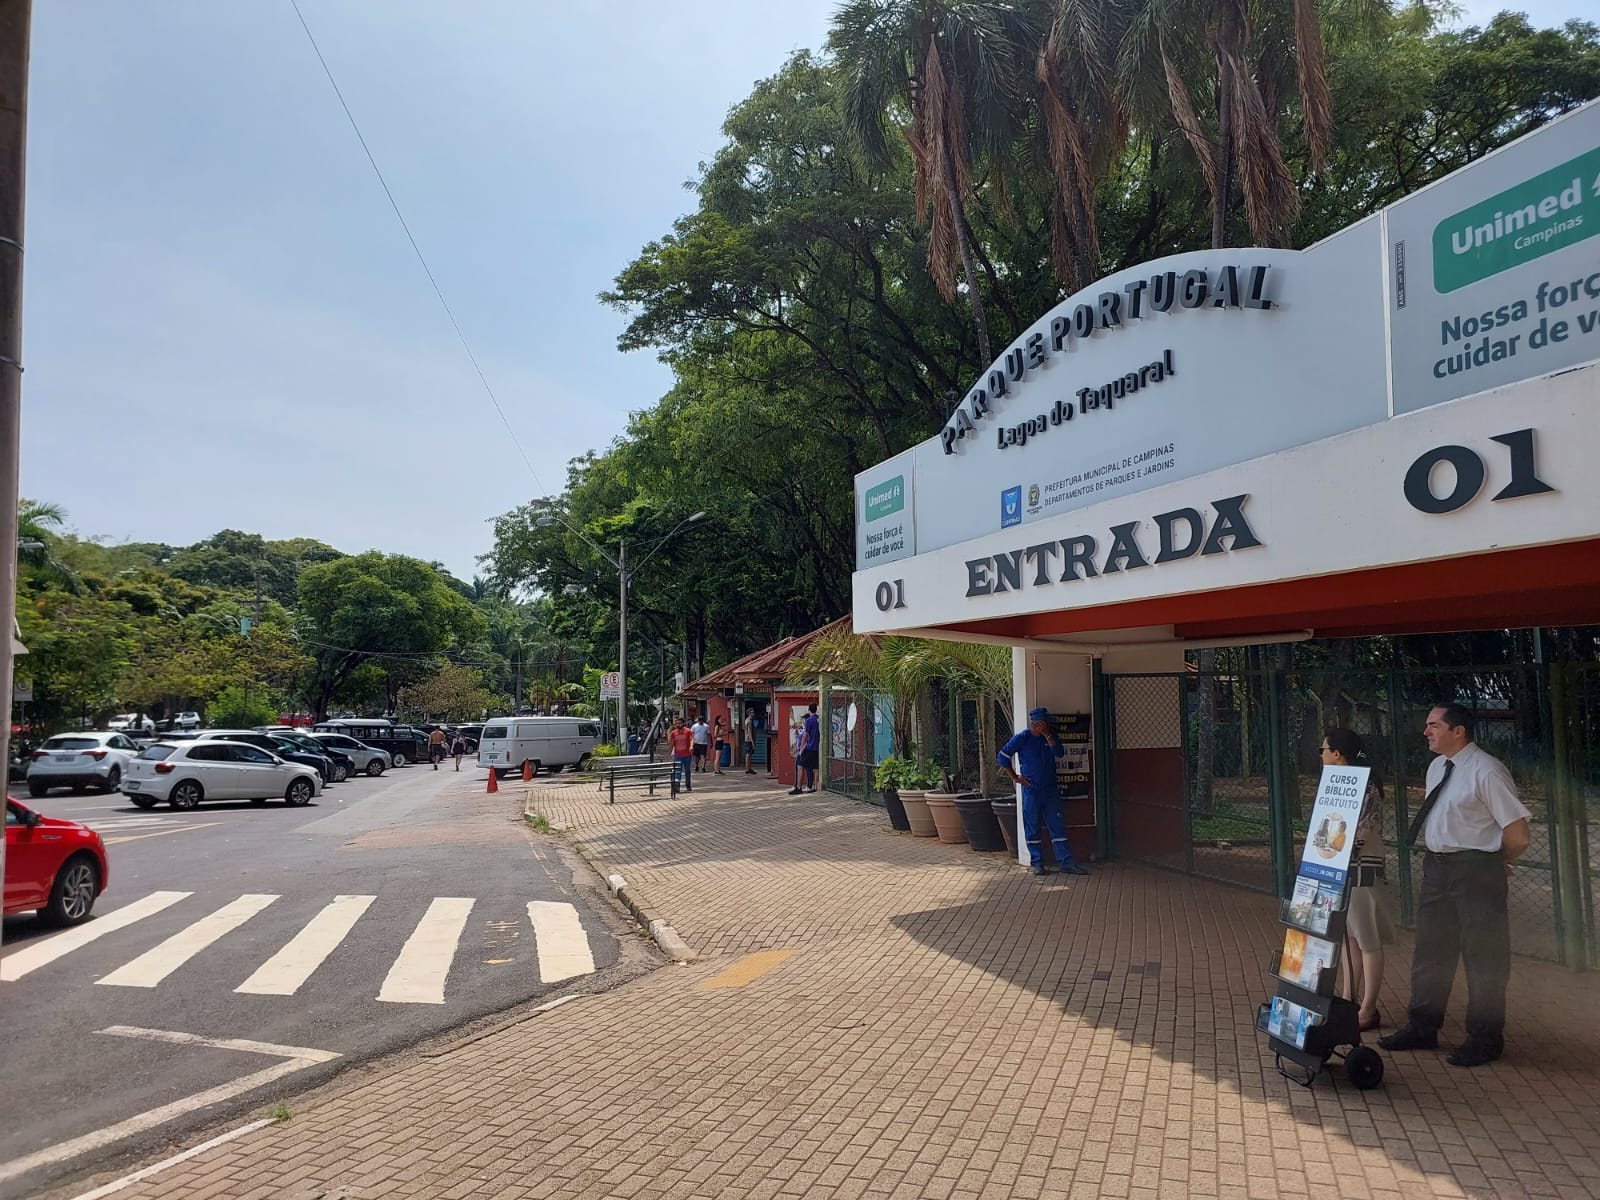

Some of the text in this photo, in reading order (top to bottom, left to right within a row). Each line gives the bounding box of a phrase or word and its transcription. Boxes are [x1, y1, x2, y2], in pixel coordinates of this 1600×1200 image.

[1452, 177, 1582, 255] Unimed
[1513, 214, 1583, 250] Campinas
[1441, 299, 1528, 346] Nossa
[1536, 272, 1600, 313] forç
[941, 264, 1275, 455] PARQUE PORTUGAL
[1433, 336, 1521, 379] cuidar
[1528, 317, 1568, 349] de
[997, 349, 1174, 449] Lagoa do Taquaral
[1044, 443, 1175, 493] PREFEITURA MUNICIPAL DE CAMPINAS
[1044, 458, 1175, 507] DEPARTAMENTOS DE PARQUES E JARDINS
[1403, 427, 1557, 515] 01
[868, 487, 893, 507] Unimed
[865, 537, 904, 560] cuidar de você
[866, 523, 903, 545] Nossa força é
[964, 493, 1264, 598] ENTRADA
[875, 579, 907, 612] 01
[1318, 797, 1359, 810] GRATUITO
[1325, 784, 1358, 797] BÍBLICO
[1330, 774, 1358, 785] CURSO
